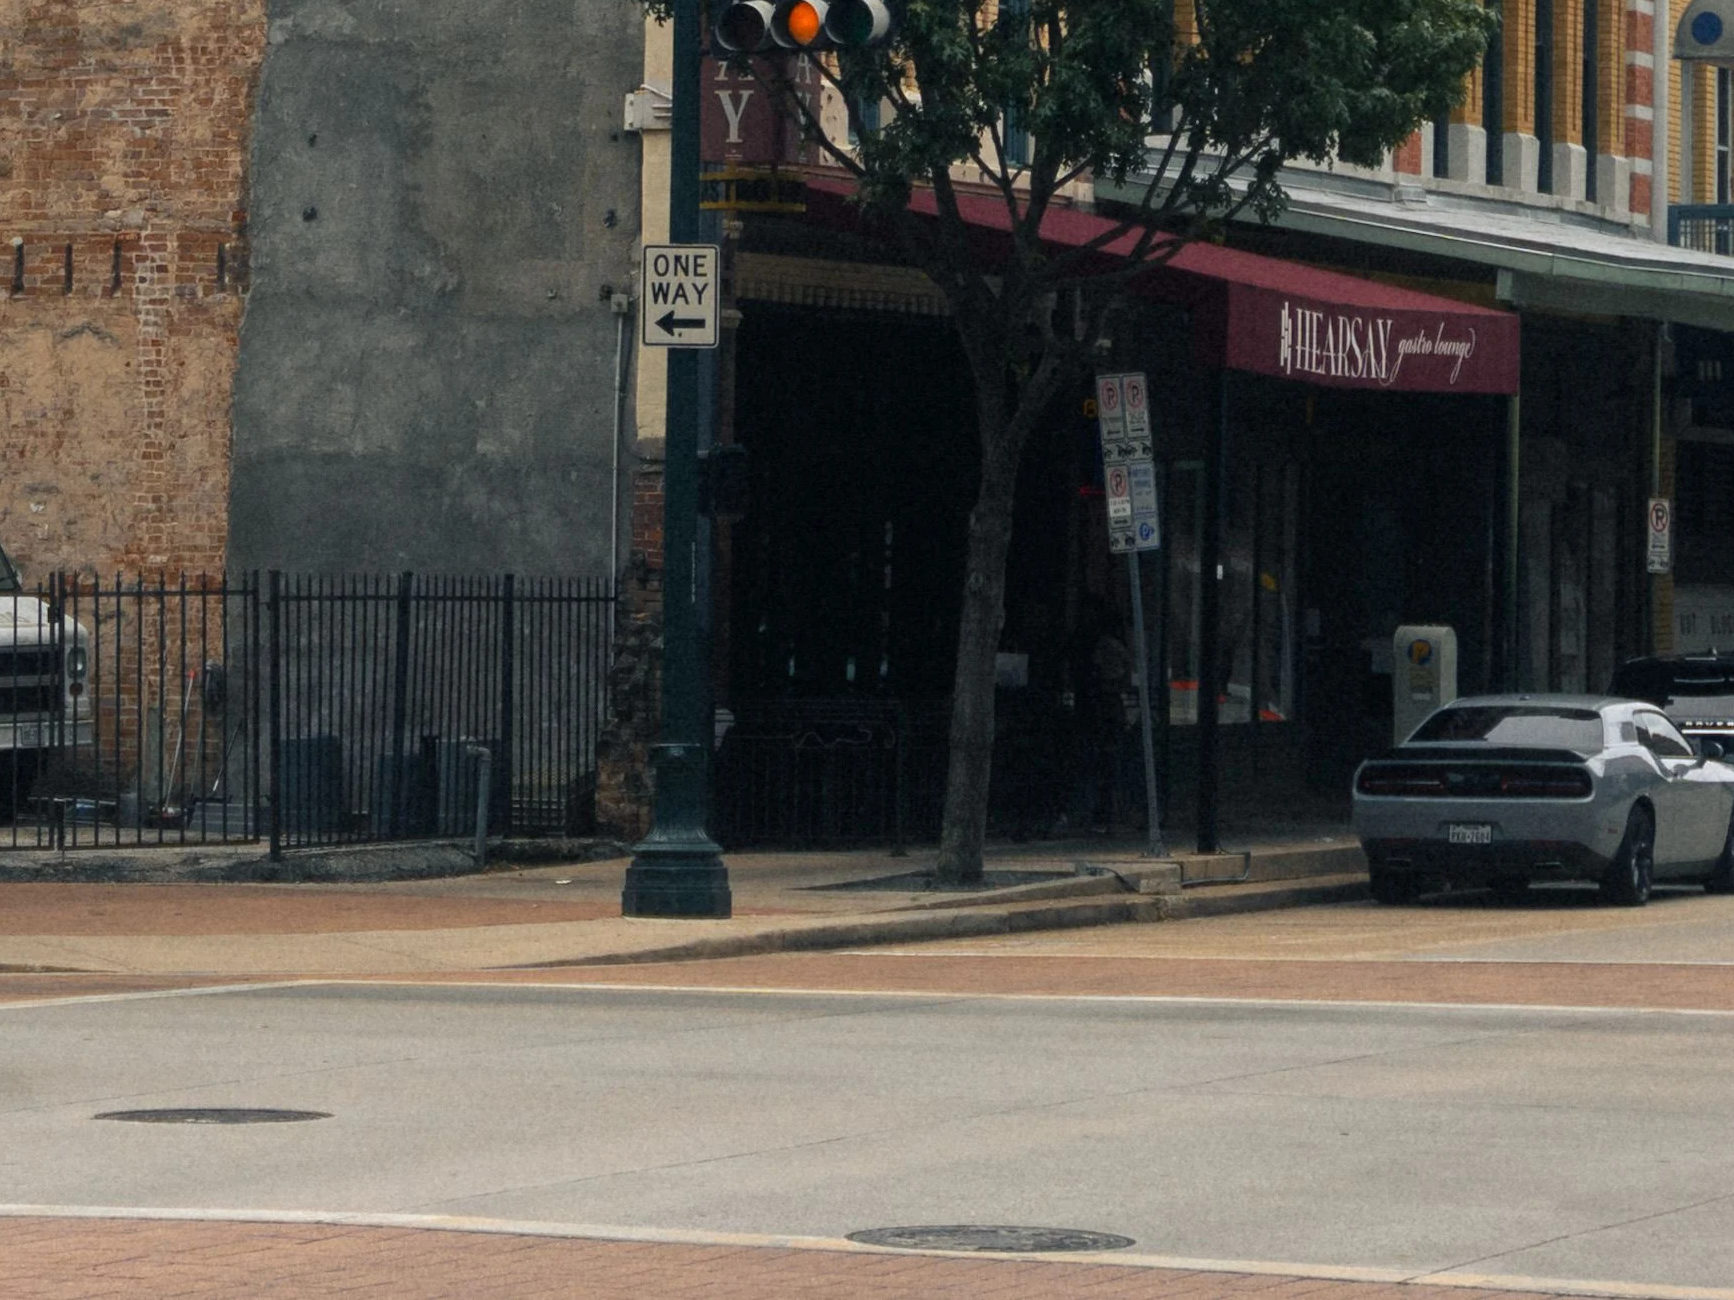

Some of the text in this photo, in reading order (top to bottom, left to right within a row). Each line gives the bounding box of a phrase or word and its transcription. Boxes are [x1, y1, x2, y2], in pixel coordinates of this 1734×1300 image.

[653, 253, 708, 280] ONE
[649, 279, 709, 306] WAY
[1295, 307, 1477, 385] HEARSAY gastro lounge
